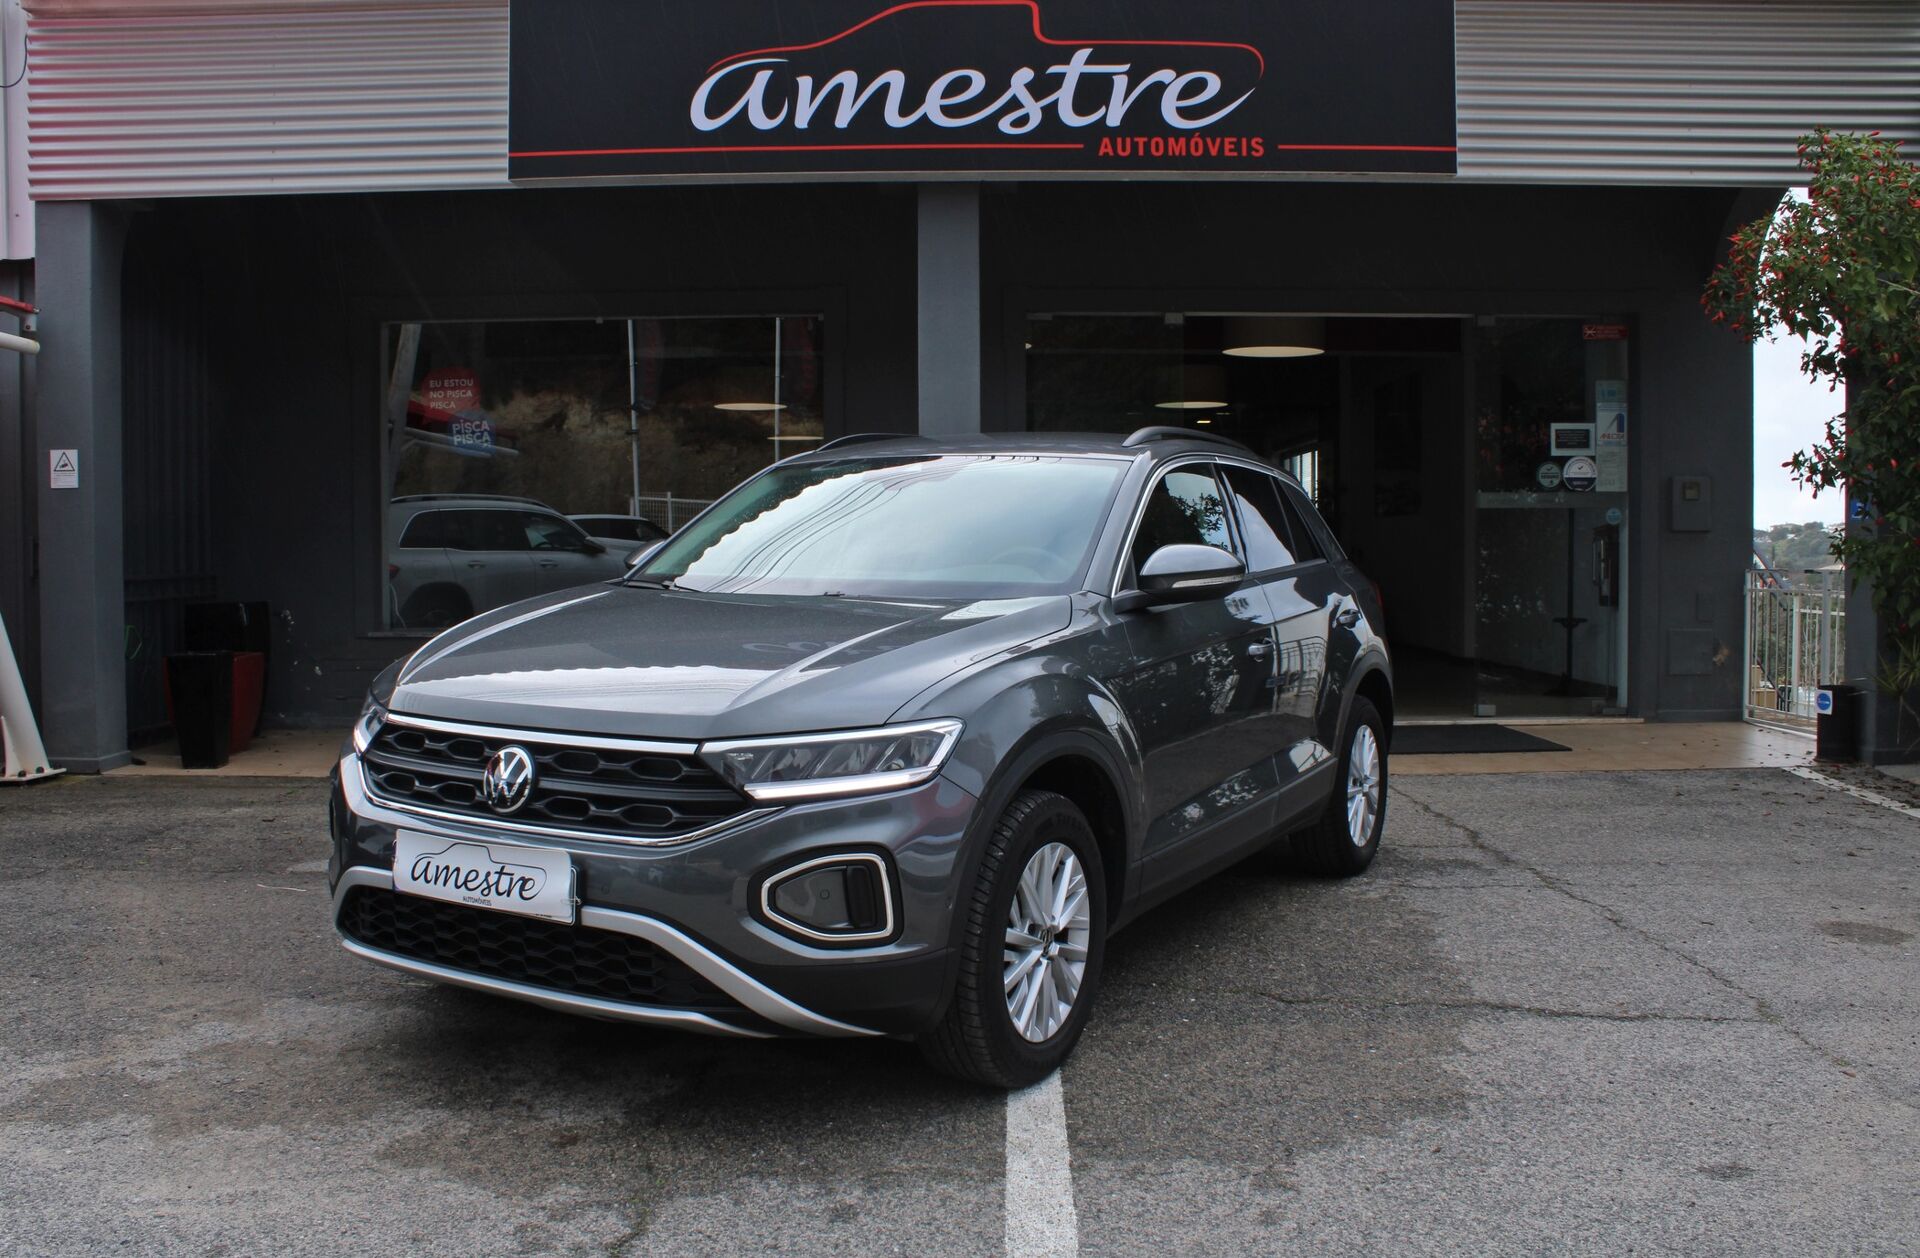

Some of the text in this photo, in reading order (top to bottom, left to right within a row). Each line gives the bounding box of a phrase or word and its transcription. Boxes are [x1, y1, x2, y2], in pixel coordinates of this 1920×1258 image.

[691, 48, 1255, 134] amestre
[1098, 132, 1265, 157] AUTOMÓVEIS
[430, 379, 473, 388] EU ESTOU
[447, 389, 473, 398] PISCA
[411, 857, 538, 900] amestre
